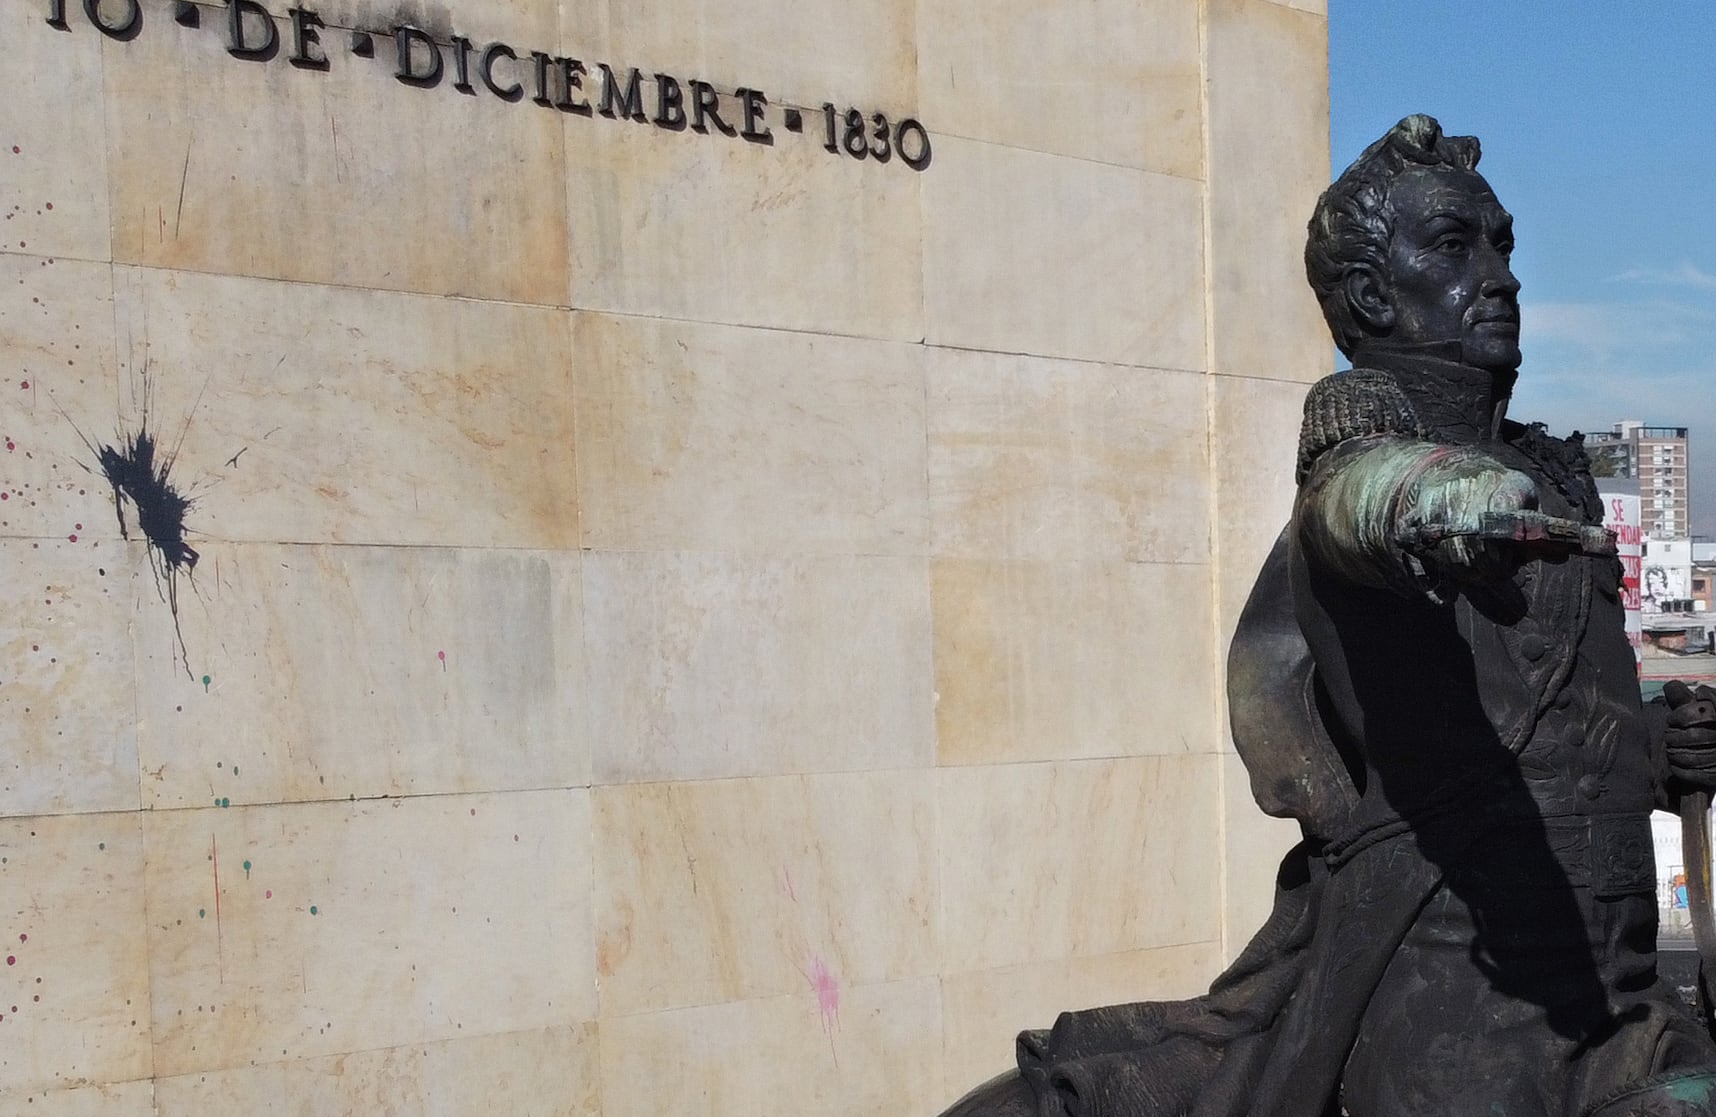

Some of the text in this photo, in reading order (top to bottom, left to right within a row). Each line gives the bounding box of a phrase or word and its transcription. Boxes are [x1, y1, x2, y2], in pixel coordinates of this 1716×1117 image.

[227, 0, 330, 71] DE
[394, 24, 774, 146] DICIEMBRE
[823, 101, 932, 171] 1830
[1611, 498, 1624, 522] SE
